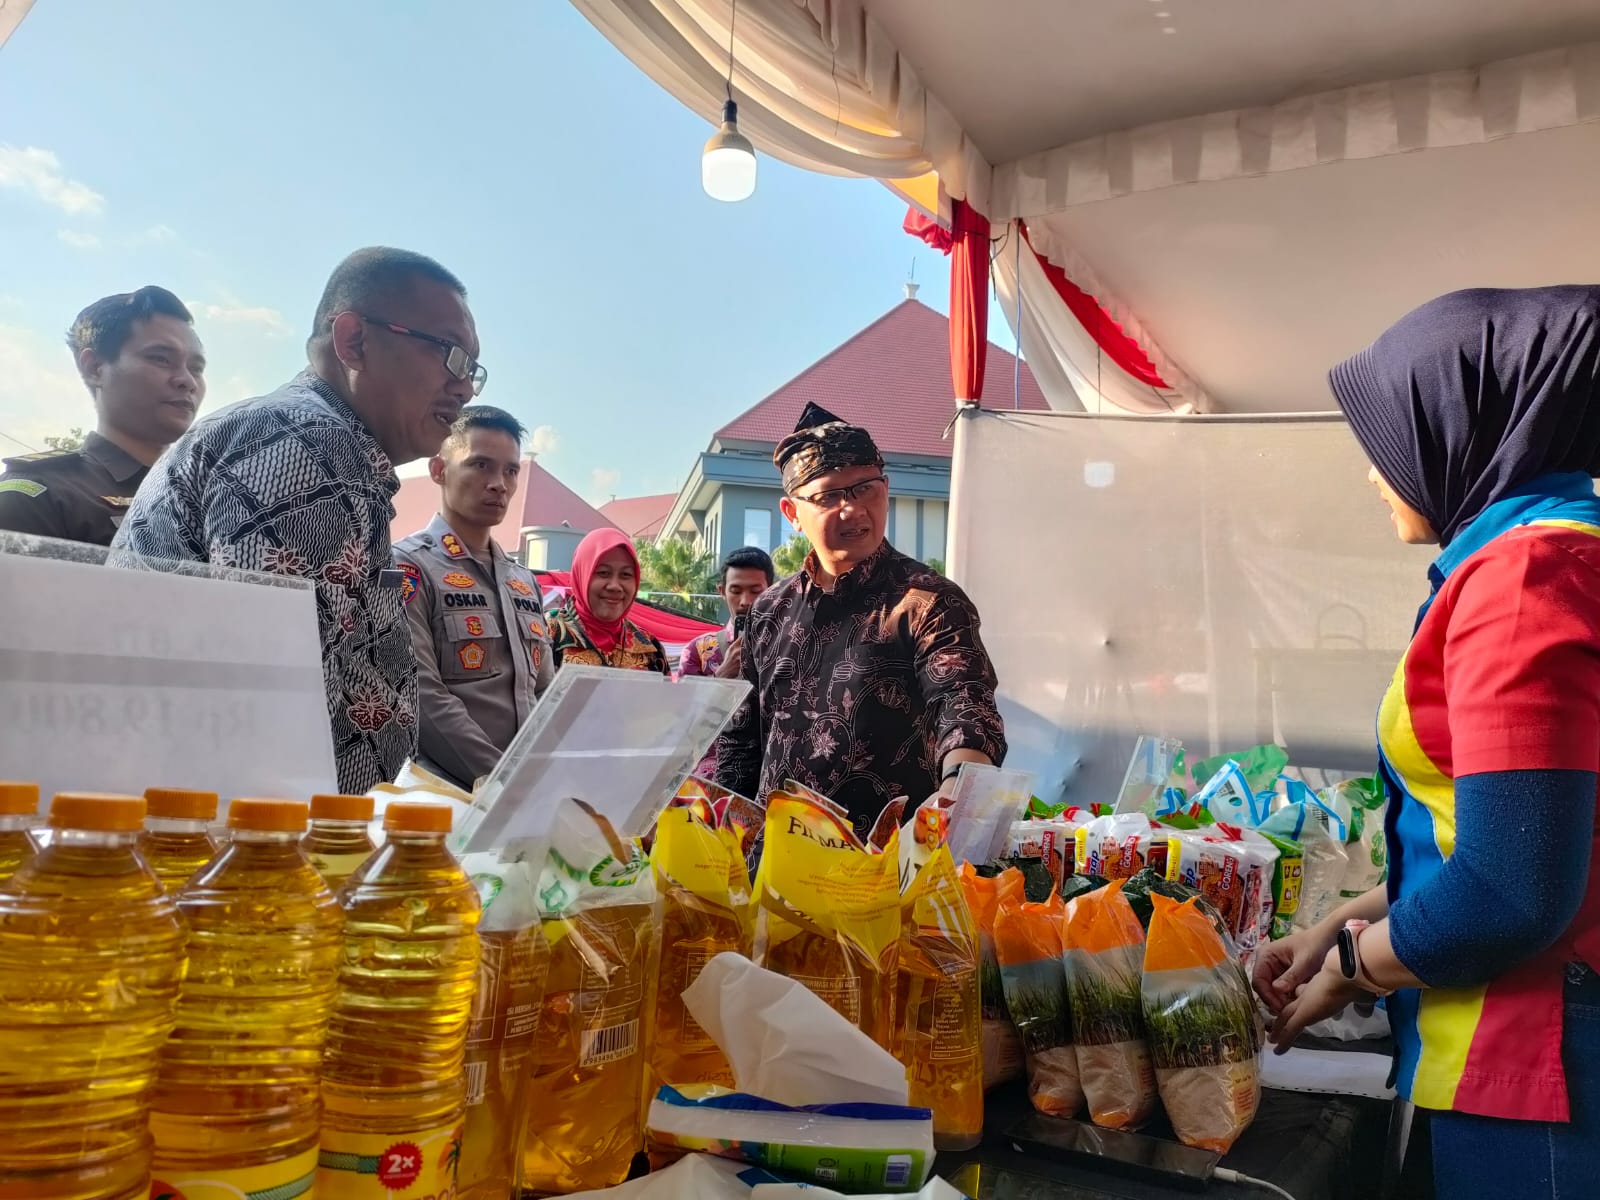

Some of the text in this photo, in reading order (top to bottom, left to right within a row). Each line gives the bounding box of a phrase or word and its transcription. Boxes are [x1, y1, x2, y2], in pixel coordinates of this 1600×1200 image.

[444, 592, 488, 608] OSKAR
[1041, 833, 1053, 866] GORENG
[1220, 857, 1234, 890] GORENG
[388, 1154, 415, 1173] 2x
